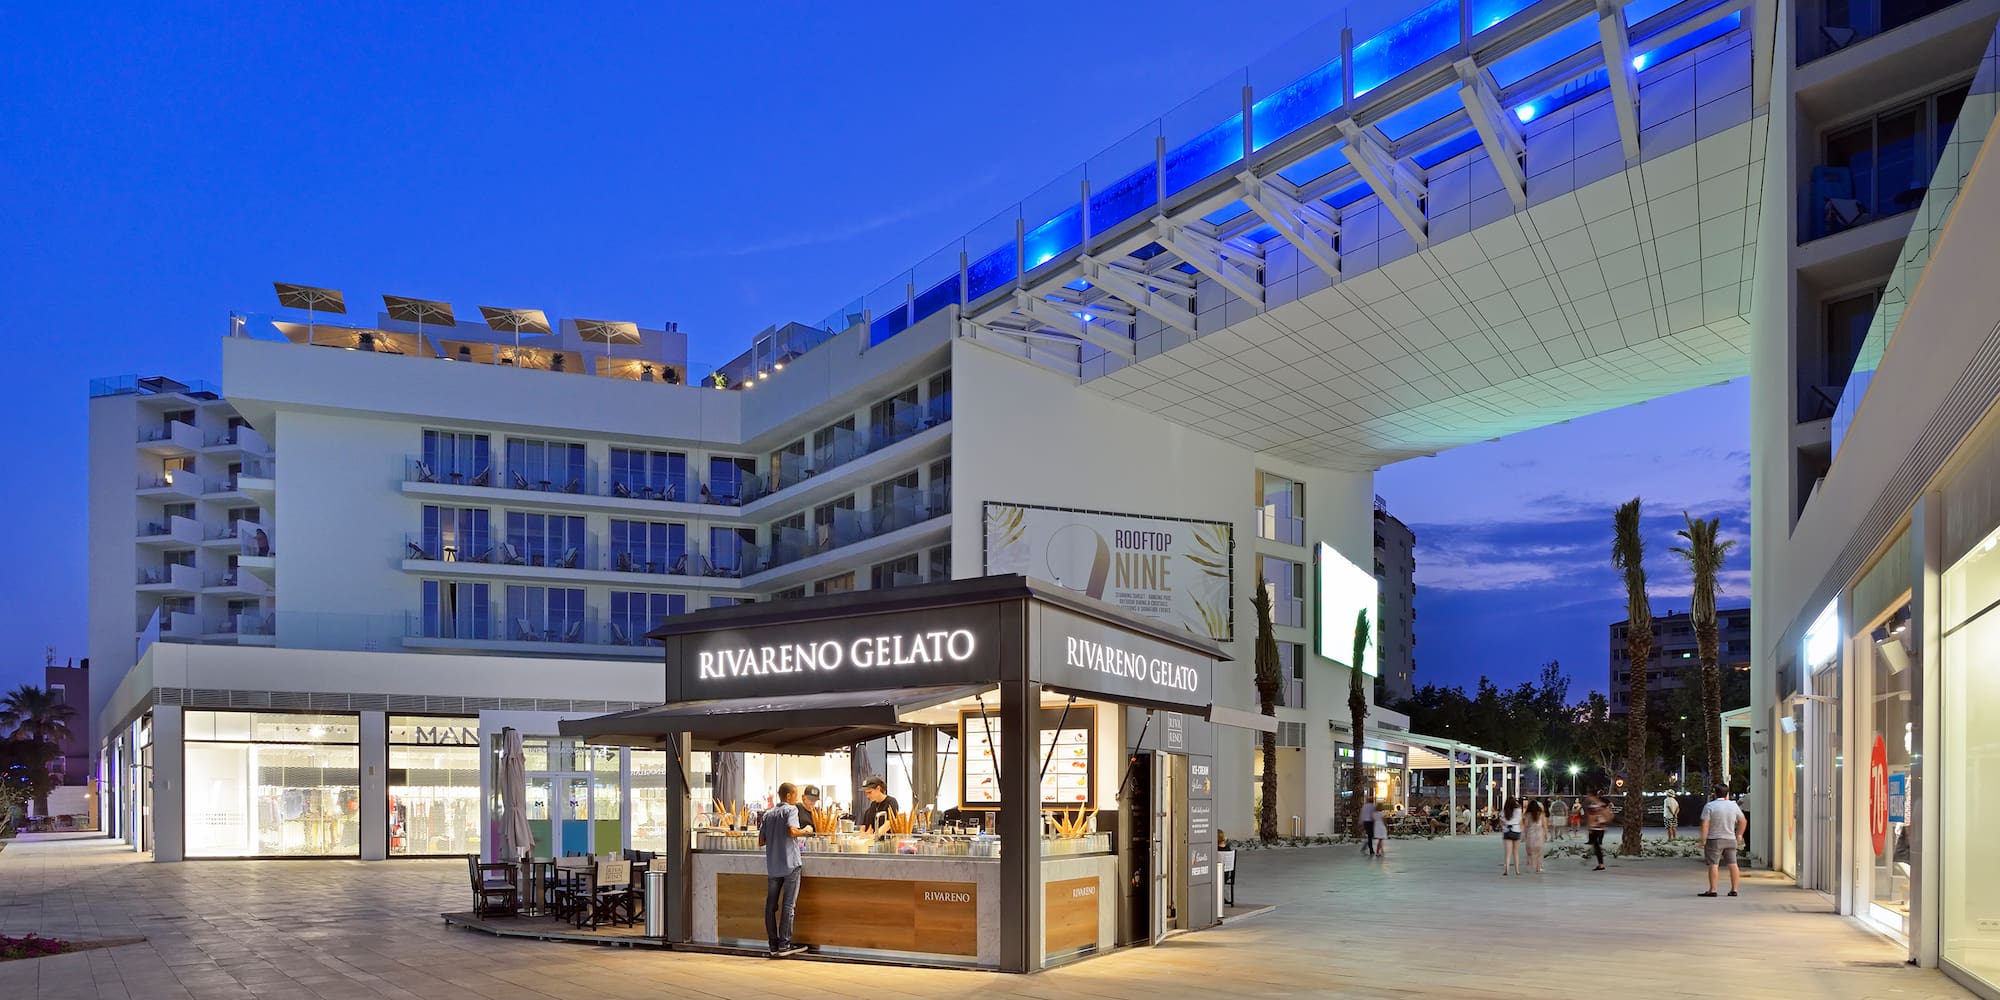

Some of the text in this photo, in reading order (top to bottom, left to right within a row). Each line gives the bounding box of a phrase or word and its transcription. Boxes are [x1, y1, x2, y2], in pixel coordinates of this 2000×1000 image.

[1115, 529, 1172, 552] ROOFTOP
[1115, 551, 1172, 591] NINE
[699, 629, 975, 679] RIVARENO GELATO
[1067, 636, 1198, 692] RIVARENO GELATO
[924, 891, 970, 903] RIVARENO
